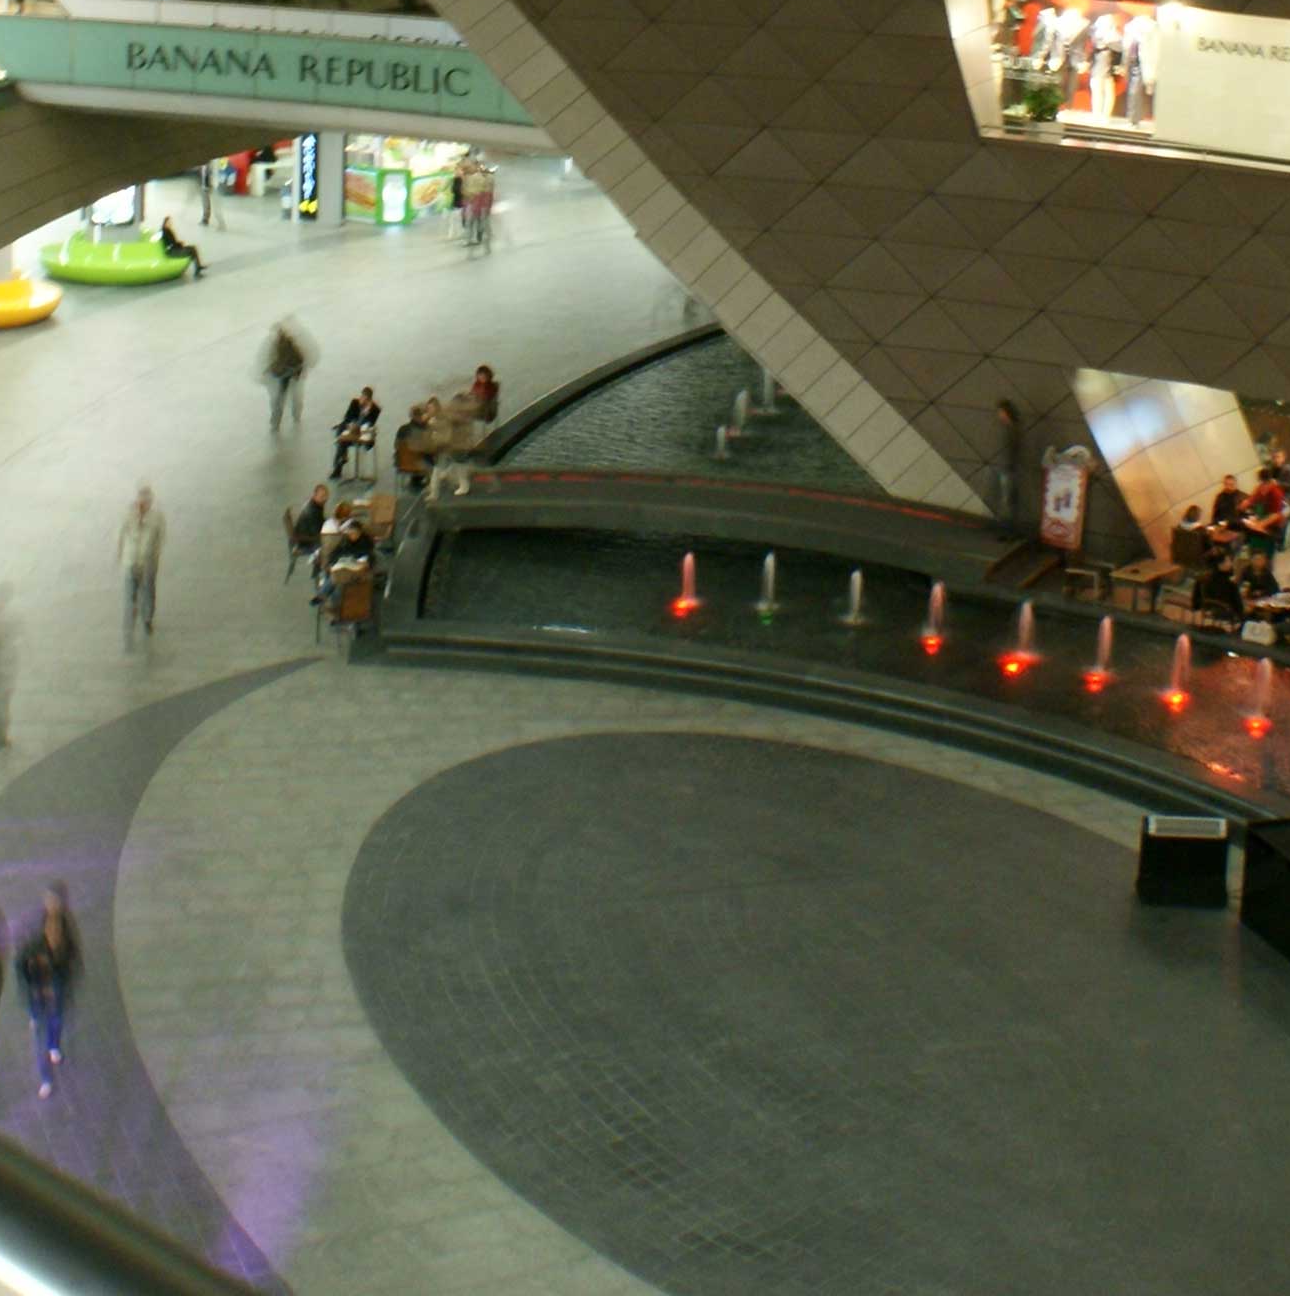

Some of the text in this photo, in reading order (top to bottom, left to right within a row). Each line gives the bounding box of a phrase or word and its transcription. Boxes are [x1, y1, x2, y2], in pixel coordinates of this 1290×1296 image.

[1197, 37, 1265, 59] BANANA
[126, 42, 471, 97] BANANA REPUBLIC
